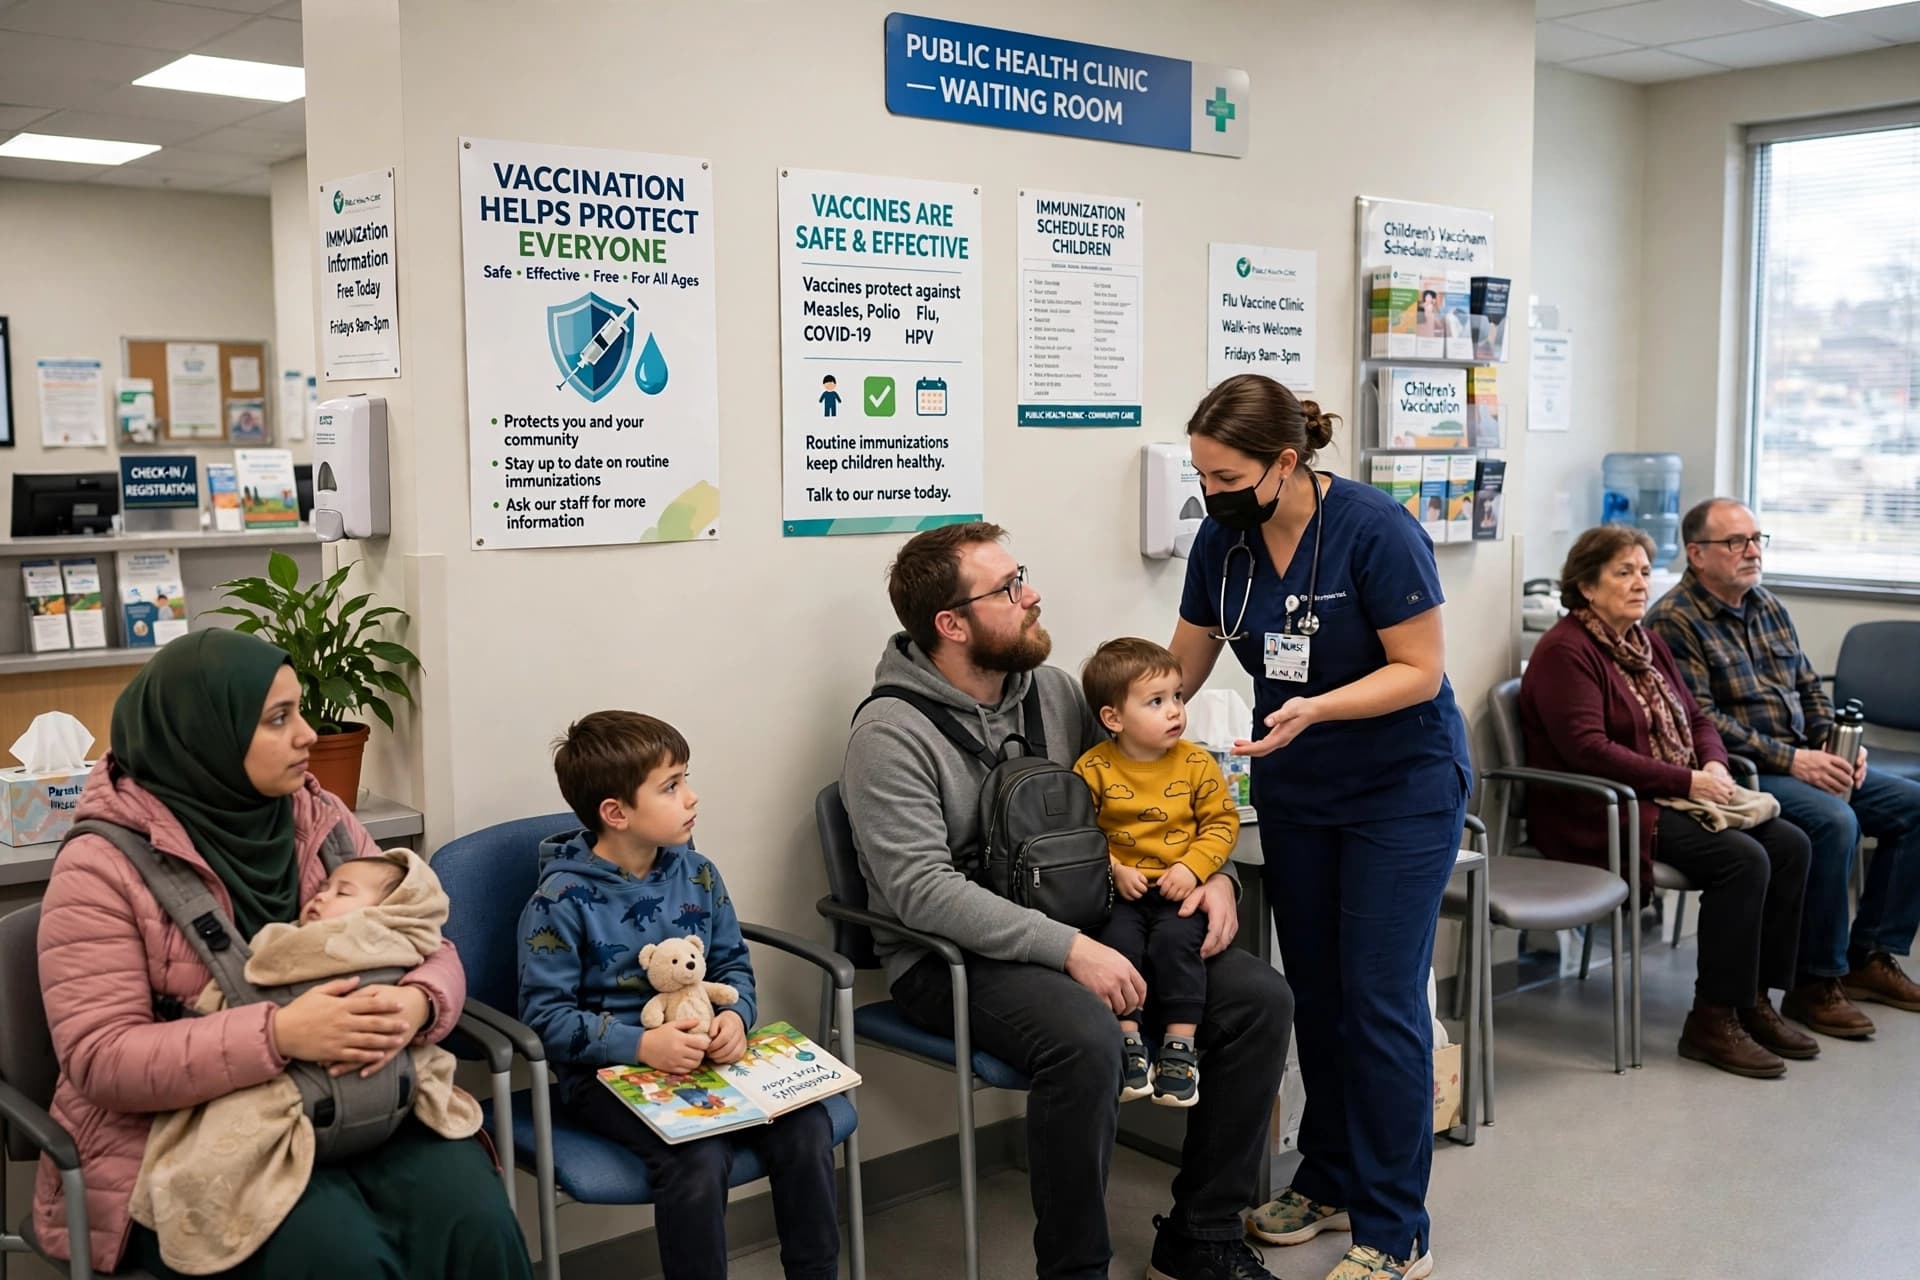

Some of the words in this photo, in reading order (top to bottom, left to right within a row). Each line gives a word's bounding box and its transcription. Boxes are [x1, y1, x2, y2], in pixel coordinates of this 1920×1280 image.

[907, 34, 990, 69] PUBLIC
[996, 48, 1078, 82] HEALTH
[1083, 61, 1148, 92] CLINIC
[940, 77, 1046, 114] WAITING
[1053, 94, 1122, 124] ROOM
[494, 163, 684, 201] VACCINATION
[480, 196, 570, 226] HELPS
[580, 203, 698, 233] PROTECT
[812, 194, 910, 223] VACCINES
[916, 203, 953, 226] ARE
[1037, 200, 1125, 221] IMMUNIZATION
[1038, 219, 1098, 237] SCHEDULE
[1102, 225, 1124, 239] FOR
[1384, 222, 1435, 241] Children's
[519, 231, 667, 263] EVERYONE
[796, 225, 846, 251] SAFE
[853, 229, 866, 252] &
[873, 231, 968, 259] EFFECTIVE
[1053, 239, 1111, 256] CHILDREN
[328, 251, 389, 273] Information
[484, 265, 512, 279] Safe
[526, 267, 580, 281] Effective
[594, 270, 619, 282] Free
[632, 272, 649, 284] For
[653, 273, 667, 284] All
[671, 274, 699, 288] Ages
[337, 283, 354, 299] Free
[355, 279, 380, 299] Today
[803, 277, 861, 294] Vaccines
[866, 282, 912, 298] protect
[916, 283, 960, 301] against
[1222, 293, 1237, 307] Flu
[1240, 295, 1276, 310] Vaccine
[1279, 296, 1304, 311] Clinic
[804, 301, 863, 320] Measles,
[867, 304, 900, 319] Polio
[917, 306, 939, 323] Flu,
[330, 320, 354, 337] Fridays
[804, 326, 871, 342] COVID-19
[906, 329, 933, 344] HPV
[1222, 320, 1260, 335] Walk-ins
[1263, 322, 1302, 336] Welcome
[1225, 347, 1256, 364] Fridays
[1259, 348, 1300, 365] 9am-3pm
[1405, 382, 1455, 398] Children's
[1401, 399, 1459, 414] Vaccination
[504, 415, 559, 428] Protects
[563, 418, 586, 430] you
[590, 415, 612, 428] and
[616, 418, 644, 430] your
[504, 433, 578, 449] community
[806, 435, 856, 449] Routine
[860, 435, 948, 449] immunizations
[505, 456, 534, 473] Stay
[538, 460, 554, 475] up
[559, 458, 570, 469] to
[575, 455, 602, 469] date
[607, 458, 622, 468] on
[626, 455, 669, 468] routine
[807, 456, 837, 473] keep
[842, 455, 893, 469] children
[897, 454, 944, 471] healthy.
[131, 466, 181, 480] CHECK-IN
[506, 474, 601, 488] immunizations
[126, 482, 196, 496] REGISTRATION
[807, 487, 833, 501] Talk
[836, 489, 849, 501] to
[854, 489, 874, 500] our
[877, 488, 911, 500] nurse
[915, 485, 950, 502] today.
[506, 498, 530, 512] Ask
[535, 500, 555, 510] our
[560, 495, 589, 510] staff
[593, 495, 610, 508] for
[615, 498, 645, 508] more
[507, 514, 584, 529] information
